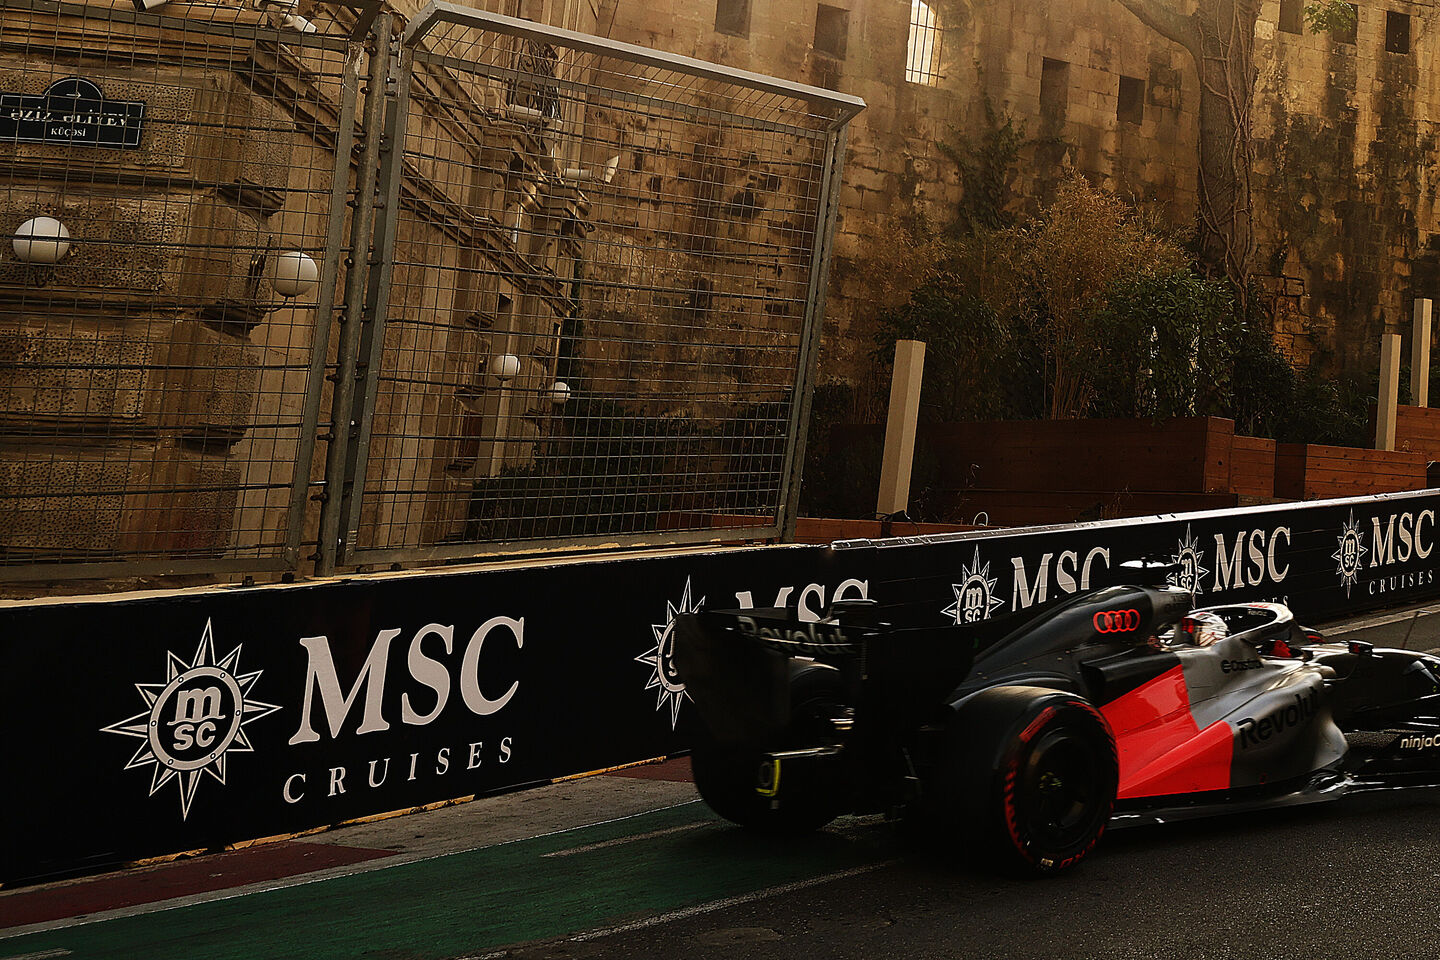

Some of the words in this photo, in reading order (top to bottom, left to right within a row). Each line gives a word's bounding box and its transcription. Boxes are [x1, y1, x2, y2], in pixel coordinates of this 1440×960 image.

[1213, 527, 1291, 593] MSC
[1370, 509, 1435, 568] MSC
[1011, 546, 1111, 612] MSC
[1369, 568, 1435, 595] CRUISES
[289, 616, 525, 745] MSC
[283, 737, 514, 804] CRUISES
